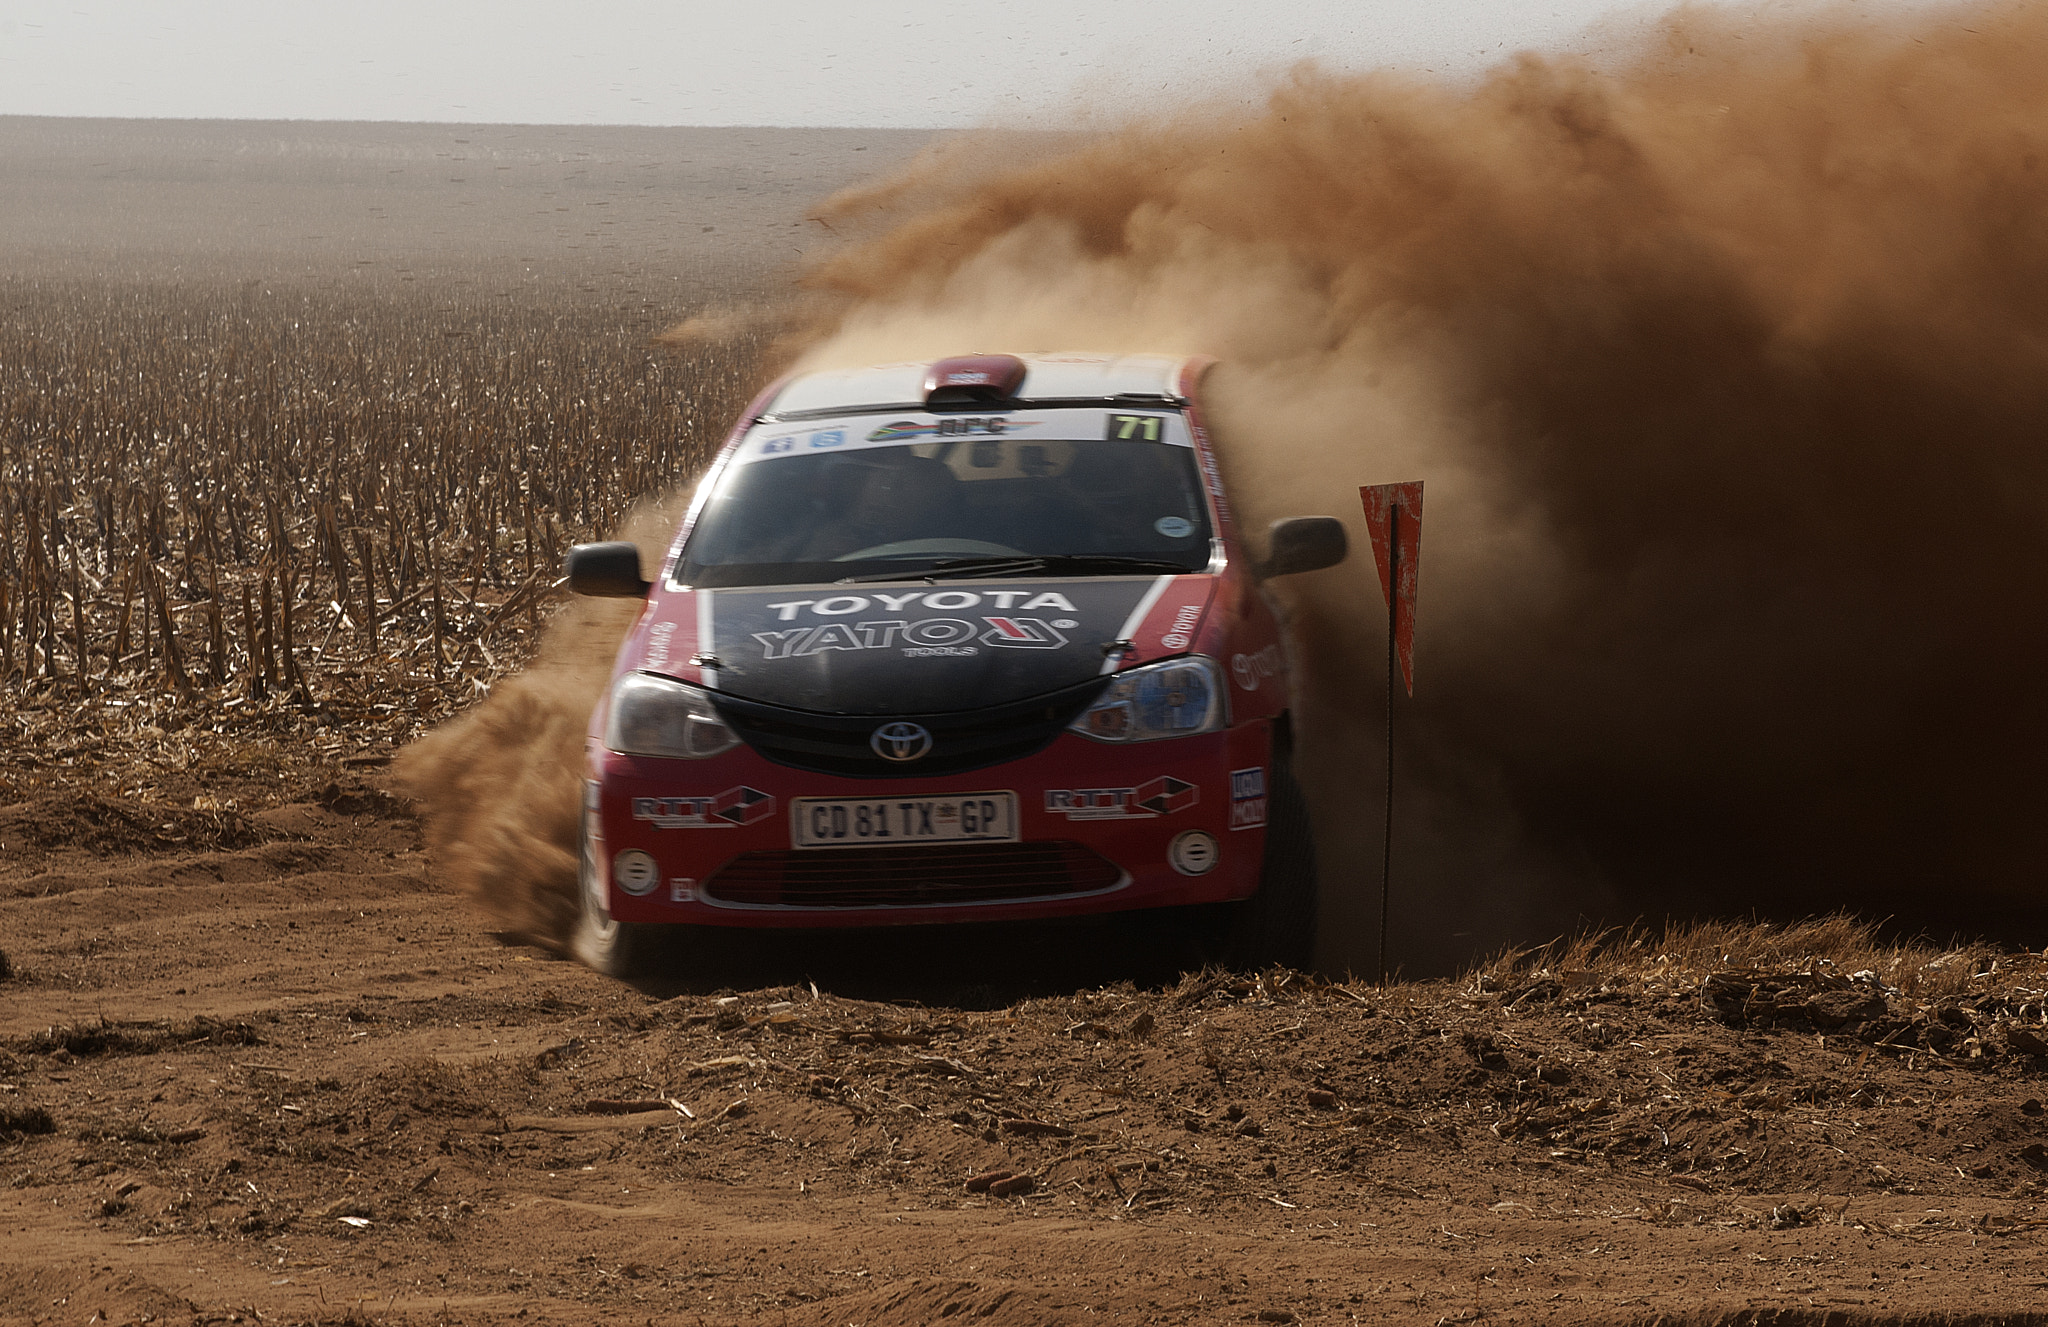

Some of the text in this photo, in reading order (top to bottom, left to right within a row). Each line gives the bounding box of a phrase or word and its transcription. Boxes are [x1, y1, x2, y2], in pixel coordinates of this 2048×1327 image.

[1115, 416, 1160, 440] 71
[767, 590, 1078, 621] TOYOTA
[1171, 605, 1203, 634] TOYOTA
[902, 647, 979, 658] TOOLS
[633, 797, 715, 817] RTT
[1045, 788, 1137, 811] RTT
[811, 800, 997, 838] CD 81 TX GP
